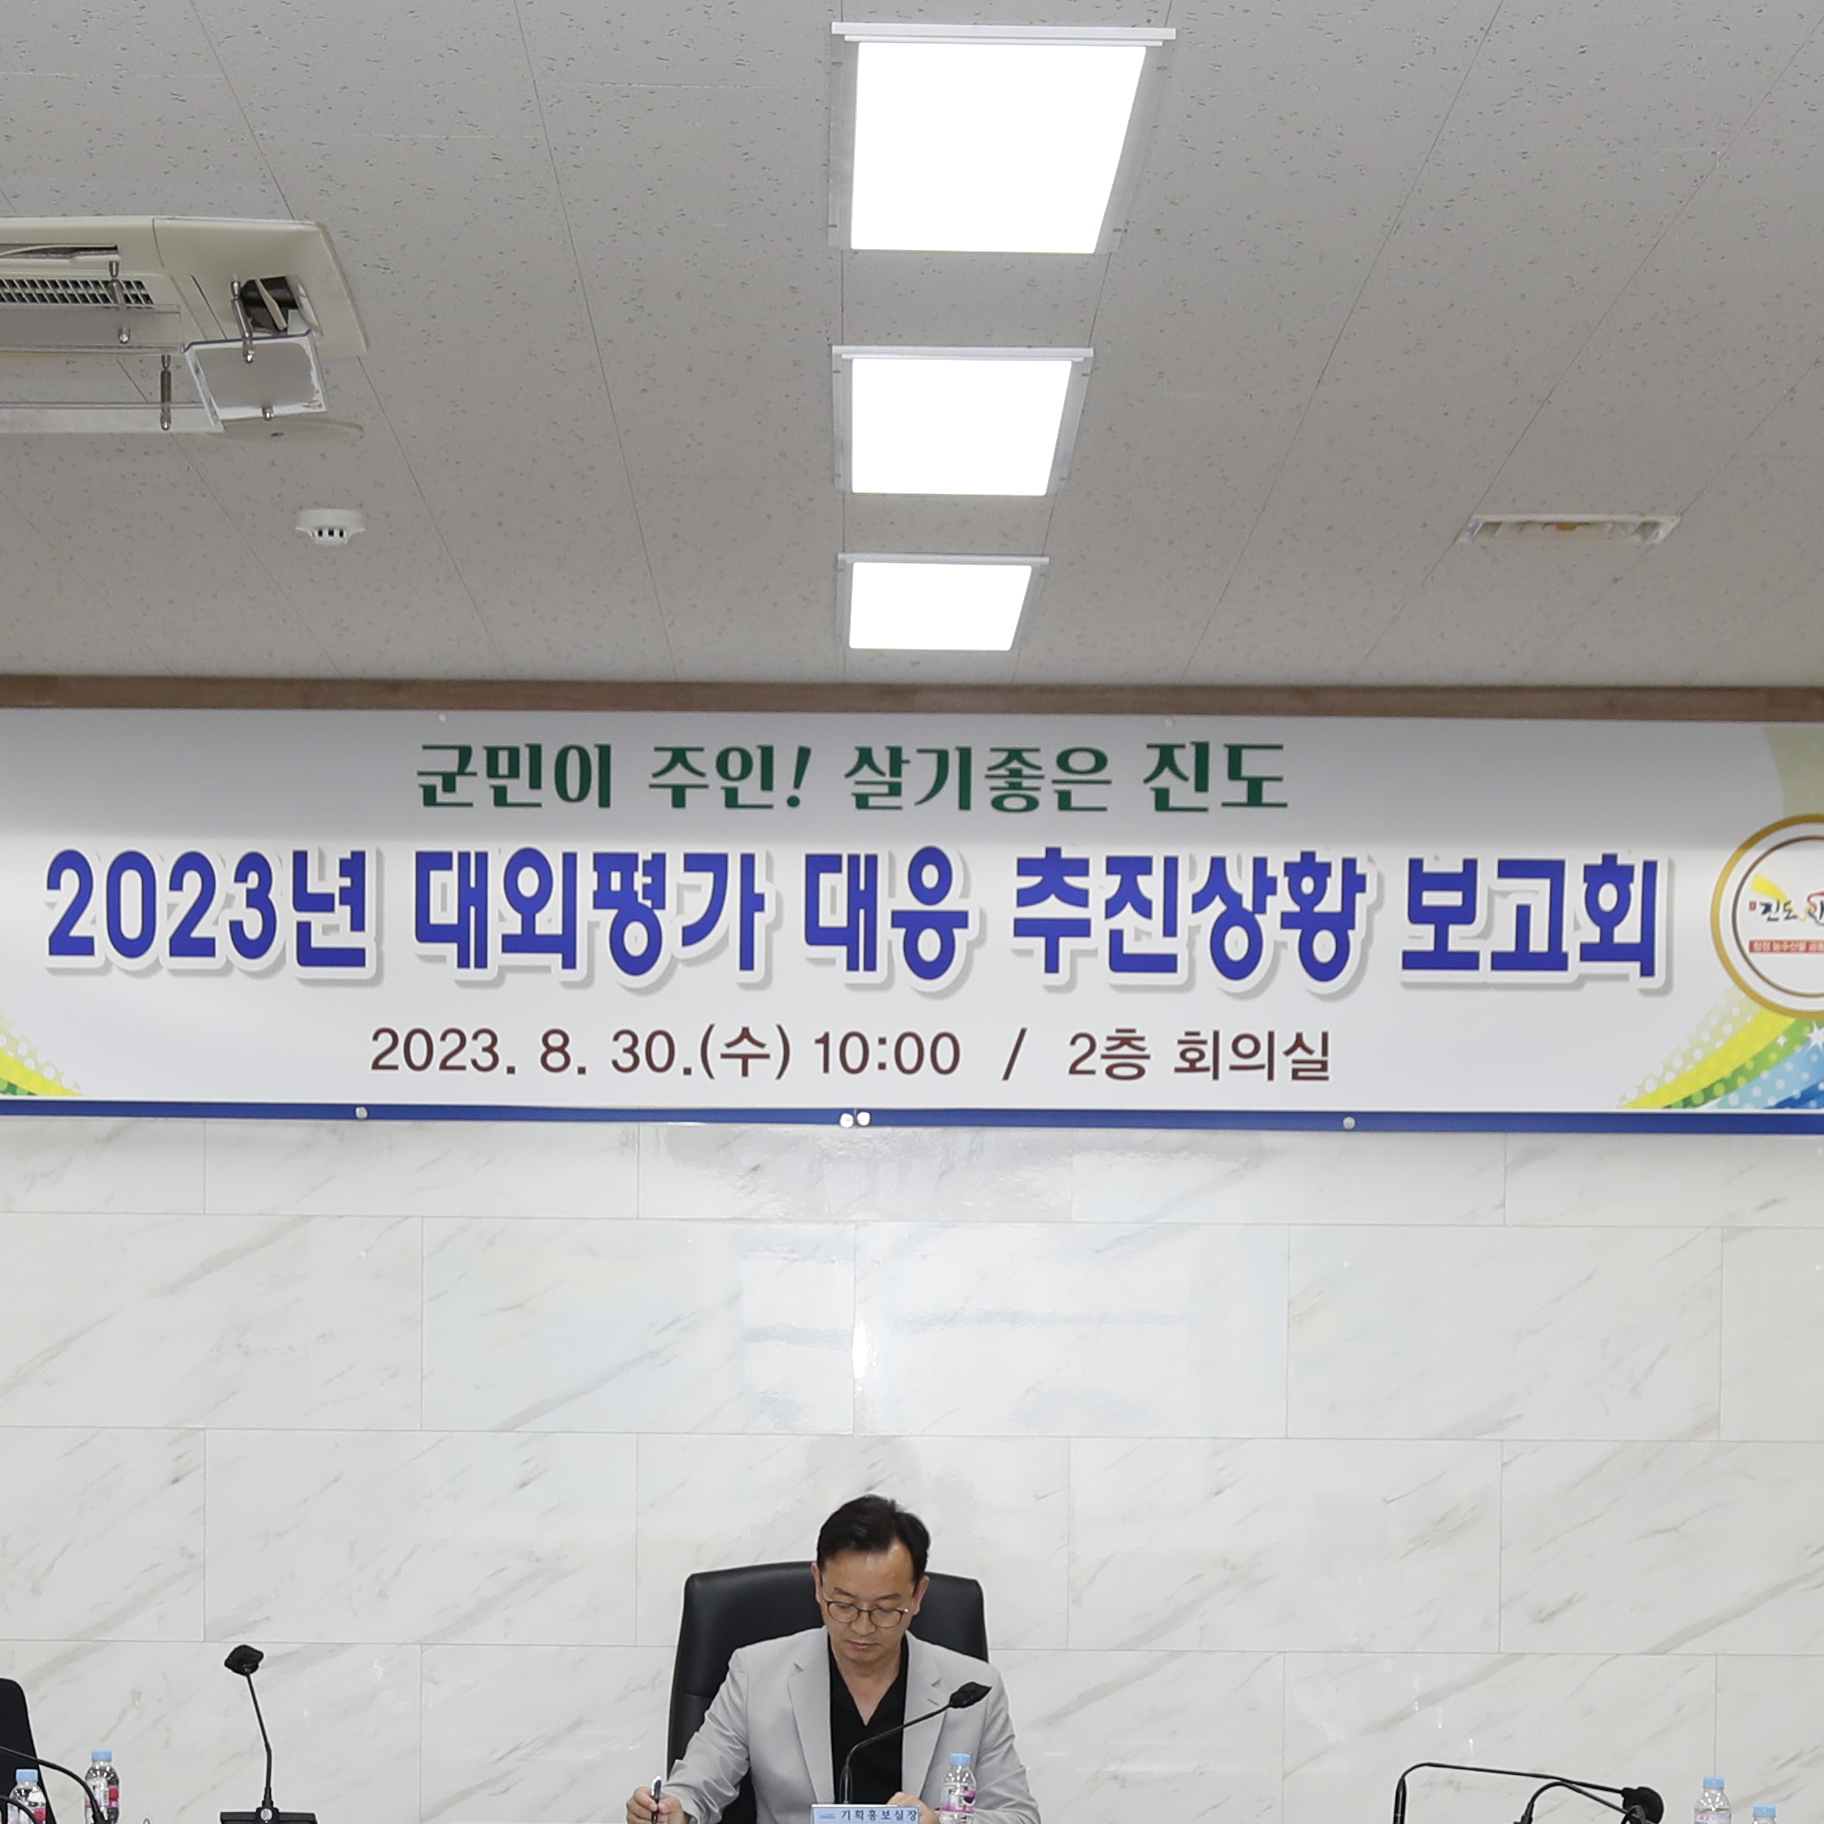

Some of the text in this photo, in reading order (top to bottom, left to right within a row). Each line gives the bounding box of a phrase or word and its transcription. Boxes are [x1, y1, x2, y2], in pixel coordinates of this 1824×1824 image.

[417, 741, 1289, 814] 군민이 주인! 살기좋은 진도
[47, 846, 1659, 983] 2023년 대외평가 대응 추진상황 보고회
[372, 1028, 517, 1077] 2023.
[541, 1029, 588, 1077] 8.
[815, 1031, 962, 1077] 10:00
[1069, 1029, 1152, 1082] 2층
[1175, 1030, 1332, 1083] 회의실
[840, 1809, 918, 1822] 기획홍보실장
